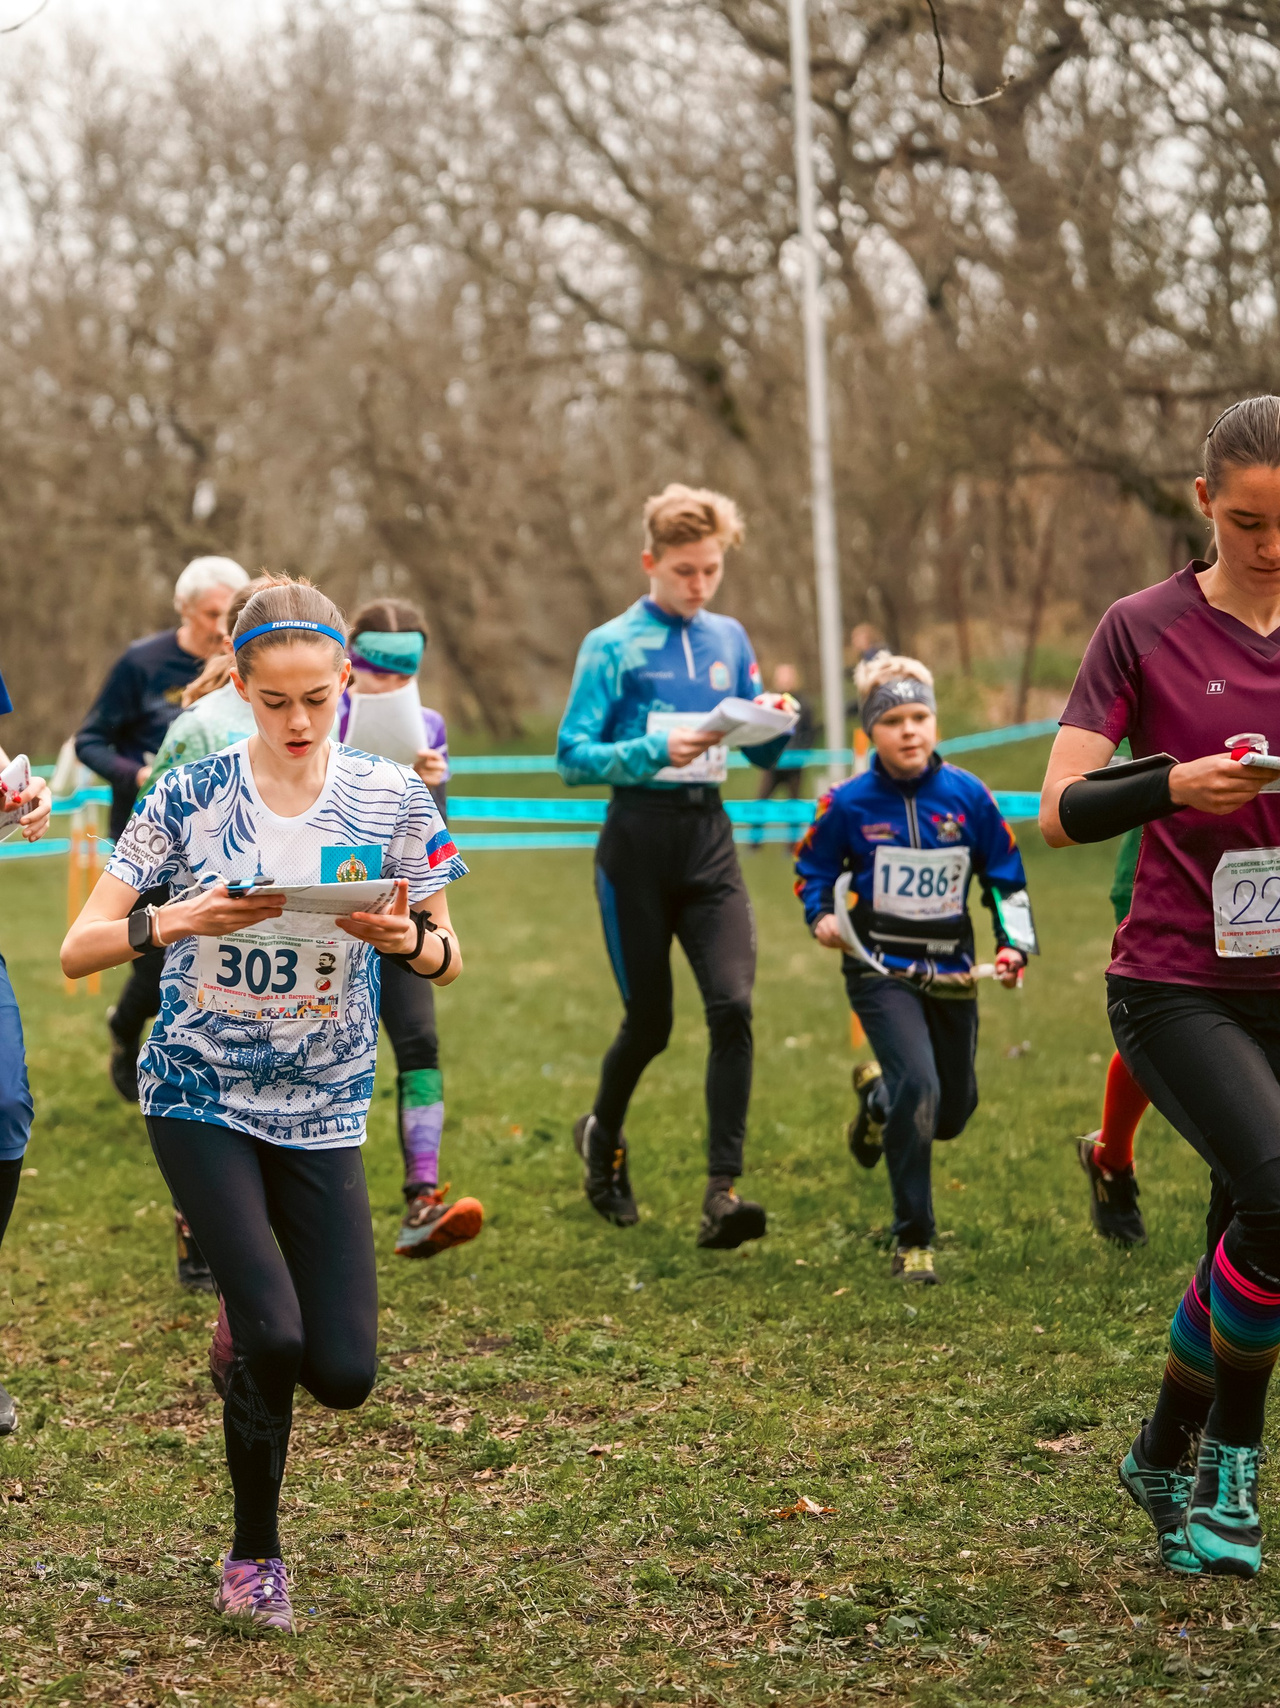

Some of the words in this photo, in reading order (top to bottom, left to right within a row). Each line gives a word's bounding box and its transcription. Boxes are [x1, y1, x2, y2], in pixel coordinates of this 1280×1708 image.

[271, 620, 318, 630] noname
[881, 864, 948, 898] 1286
[216, 944, 299, 995] 303
[203, 983, 222, 992] Памяти
